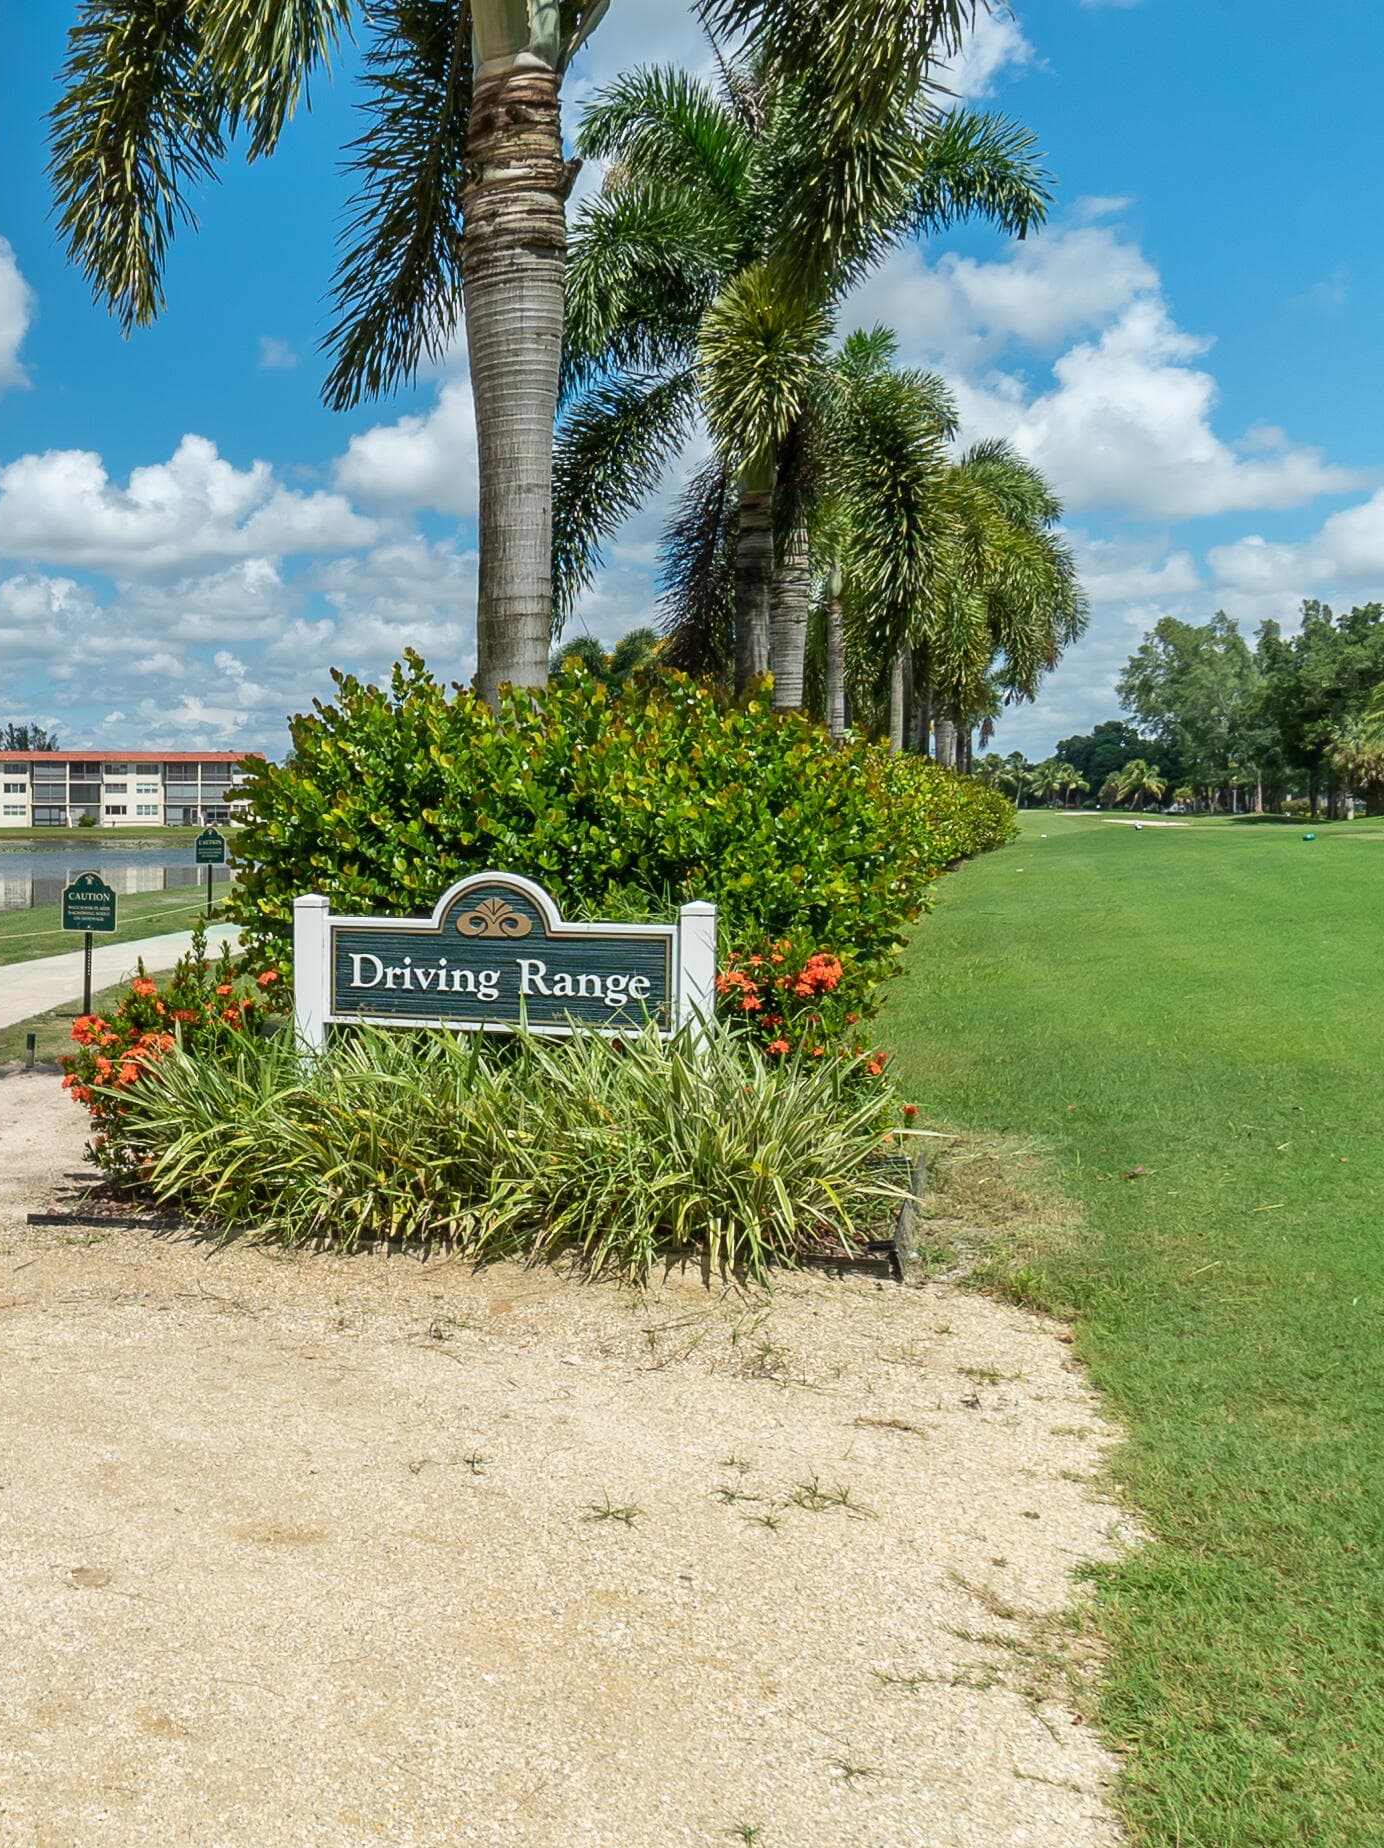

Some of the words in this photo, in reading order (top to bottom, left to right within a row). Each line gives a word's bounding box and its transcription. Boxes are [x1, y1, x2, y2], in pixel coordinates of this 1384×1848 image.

[68, 891, 111, 902] CAUTION
[347, 951, 502, 1003] Driving
[515, 958, 652, 1008] Range
